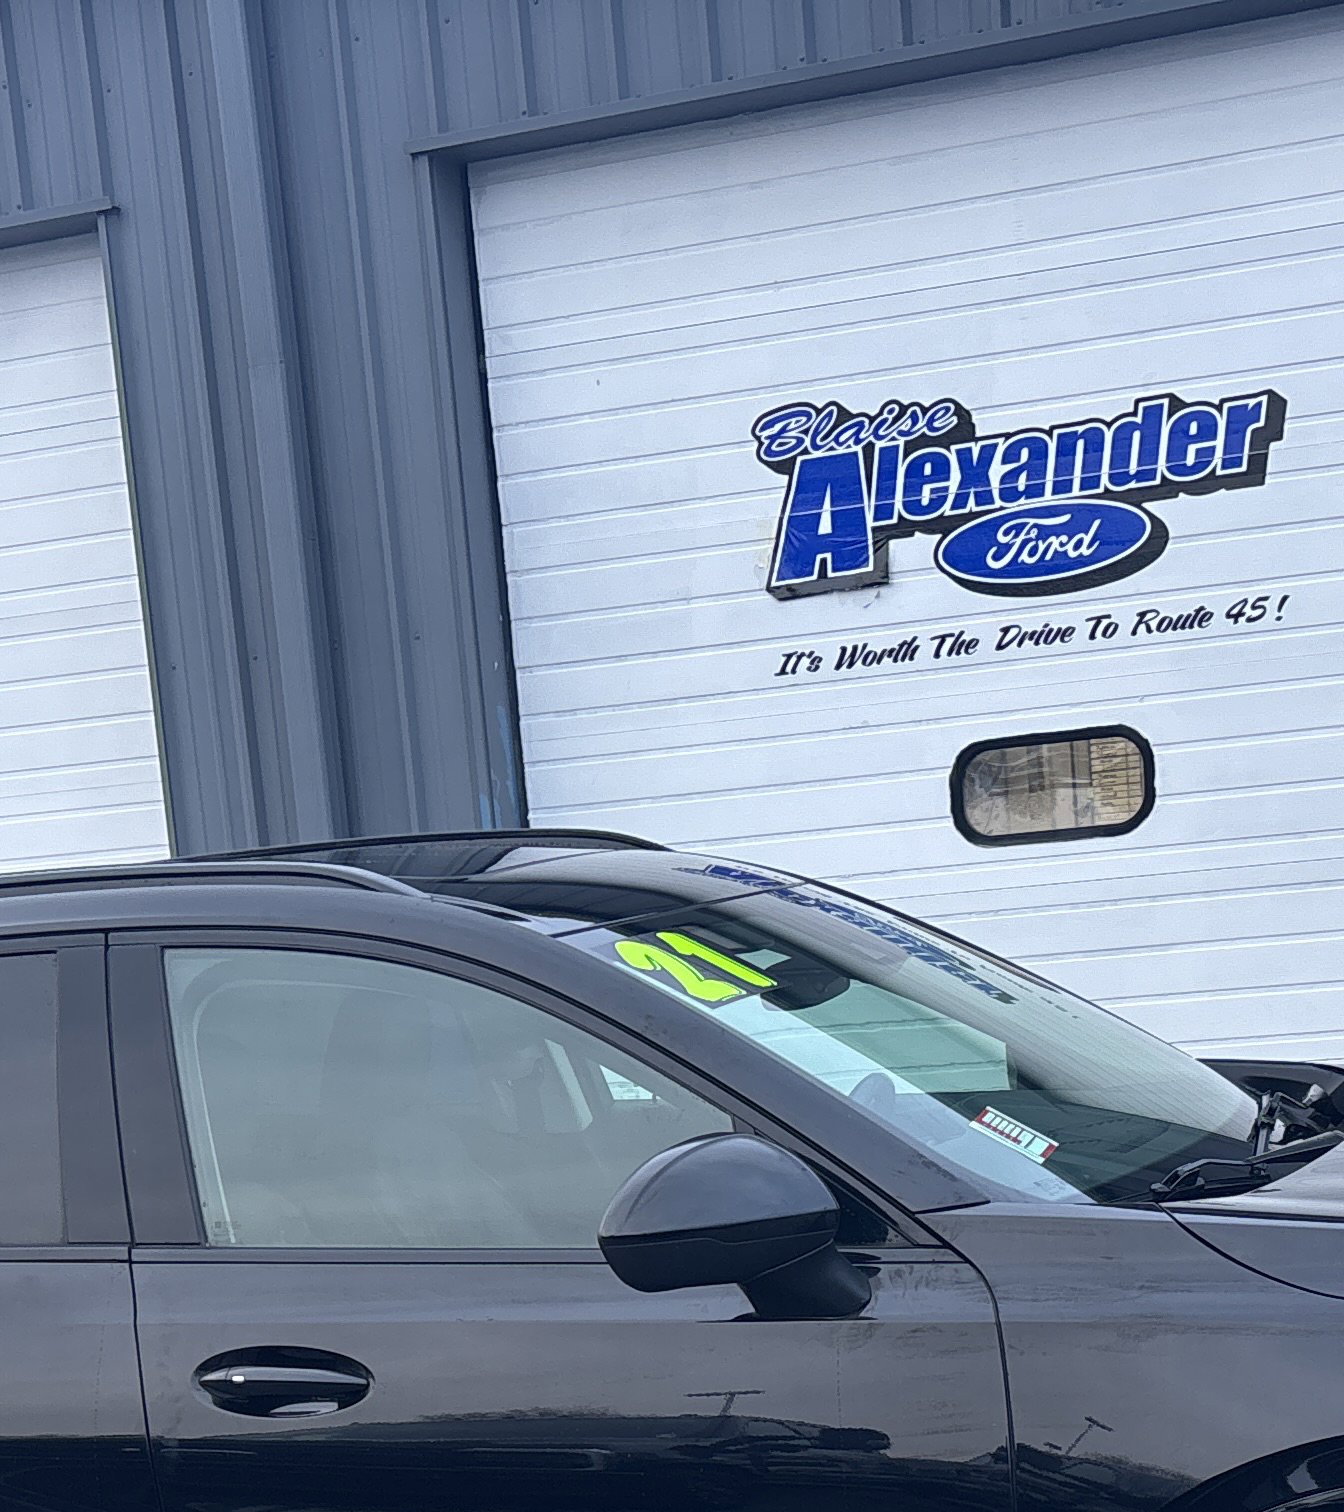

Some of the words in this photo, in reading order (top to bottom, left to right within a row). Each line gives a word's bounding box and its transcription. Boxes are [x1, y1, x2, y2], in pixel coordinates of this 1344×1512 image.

[757, 400, 956, 460] Blaise
[772, 394, 1269, 586] Alexander
[986, 517, 1102, 570] Ford
[774, 649, 823, 677] It's
[834, 640, 919, 671] Worth
[930, 630, 980, 661] The
[998, 621, 1076, 653] Drive
[1085, 614, 1120, 641] To
[1130, 605, 1215, 637] Route
[614, 931, 778, 1001] 21
